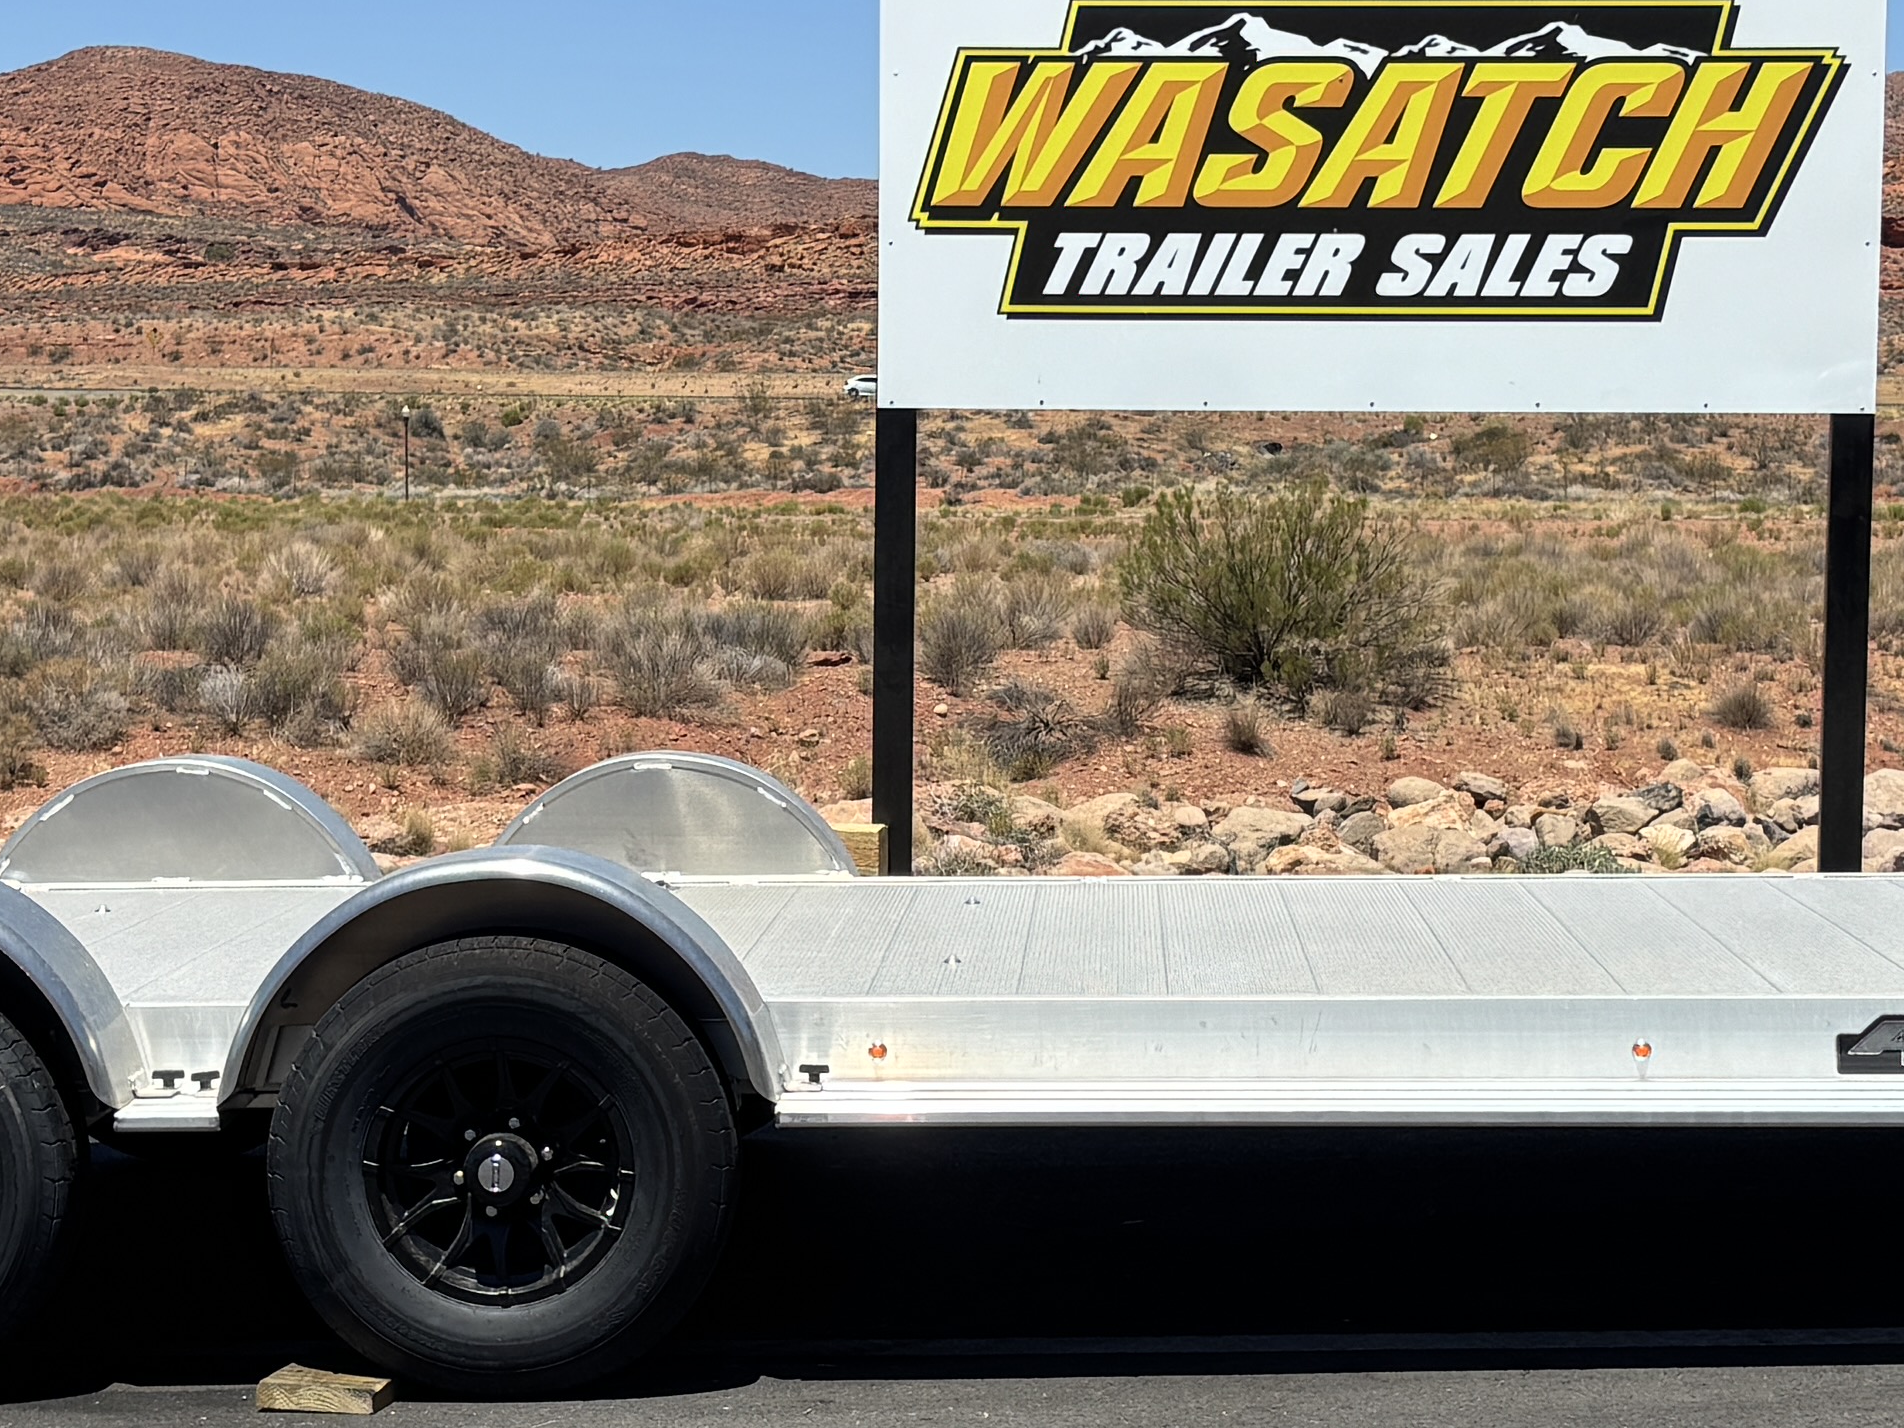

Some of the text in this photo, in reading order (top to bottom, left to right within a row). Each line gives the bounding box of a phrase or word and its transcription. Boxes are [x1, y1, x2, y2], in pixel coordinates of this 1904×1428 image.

[928, 60, 1814, 209] WASATCH
[1042, 232, 1634, 298] TRAILER SALES
